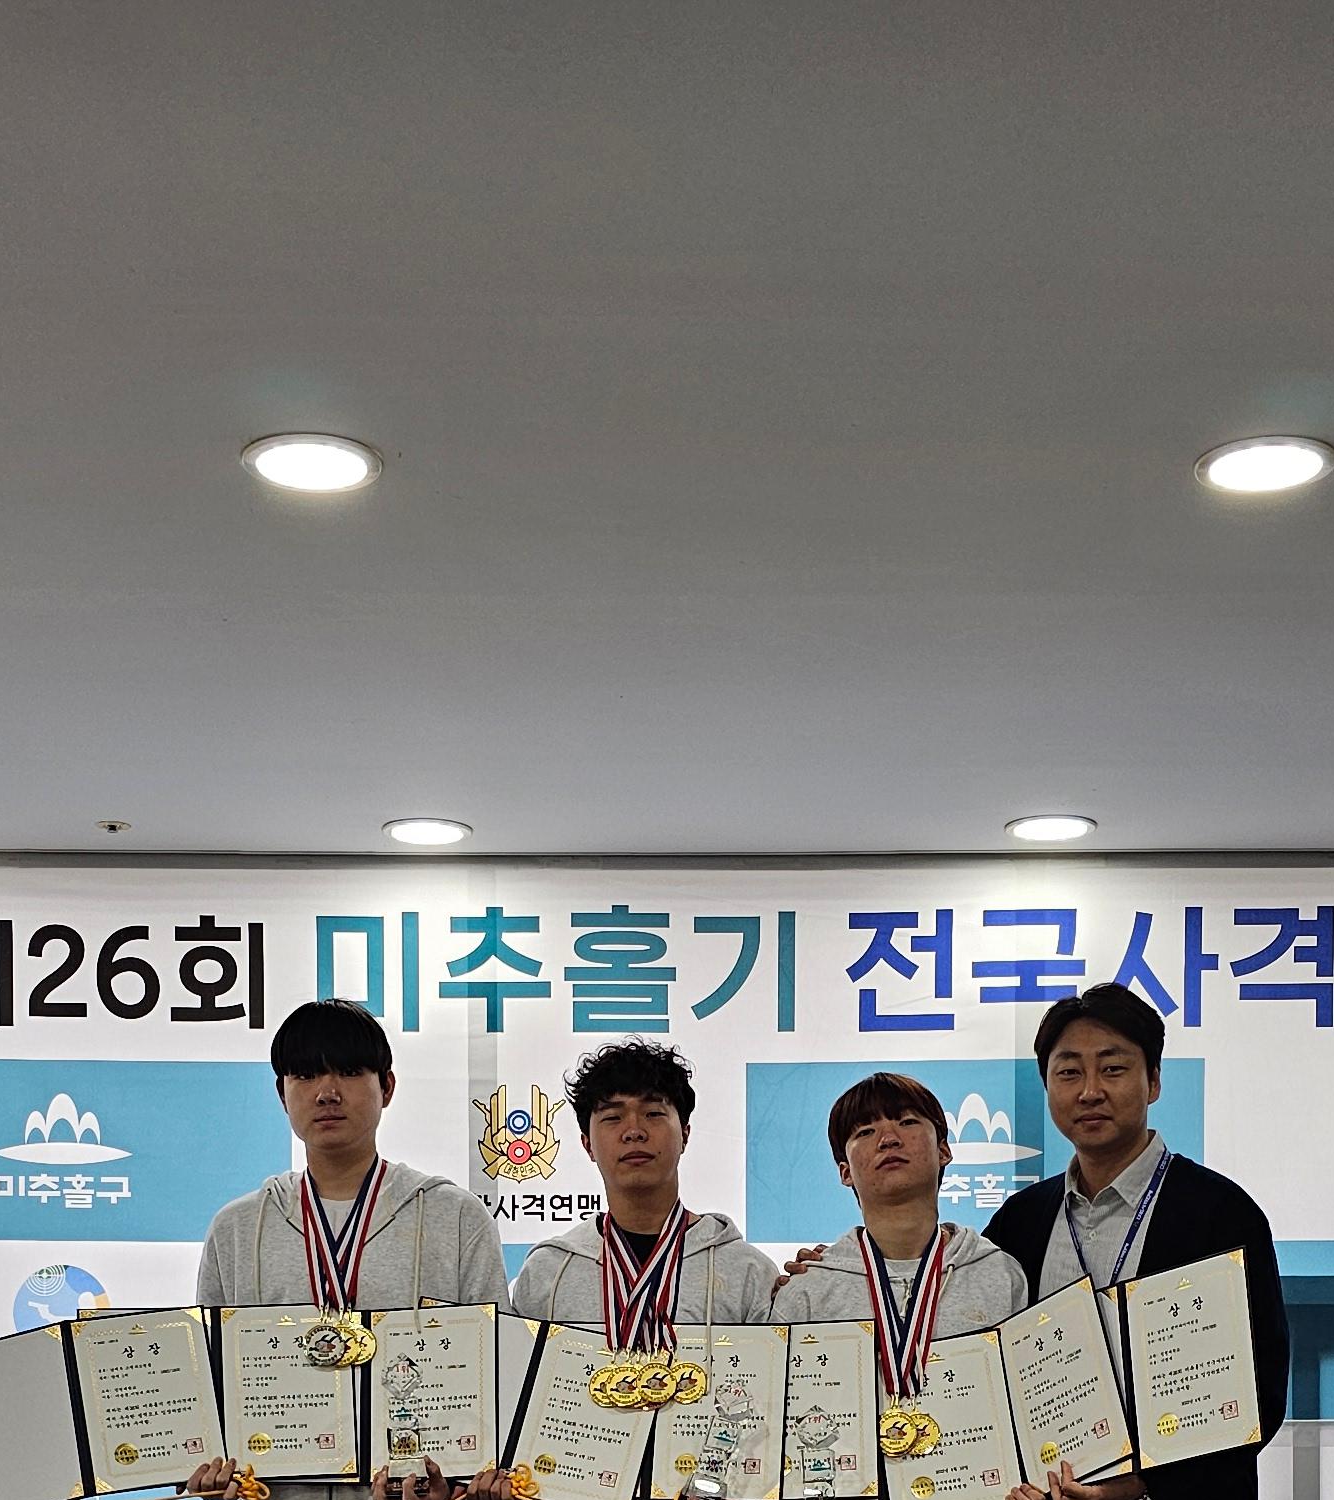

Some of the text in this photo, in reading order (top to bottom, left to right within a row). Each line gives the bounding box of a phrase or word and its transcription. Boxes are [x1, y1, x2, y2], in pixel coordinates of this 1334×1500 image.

[316, 904, 797, 1034] 미추홀기
[504, 1163, 537, 1177] 대한민국
[938, 1174, 1040, 1209] 추홀구
[477, 1194, 601, 1221] 사격연맹
